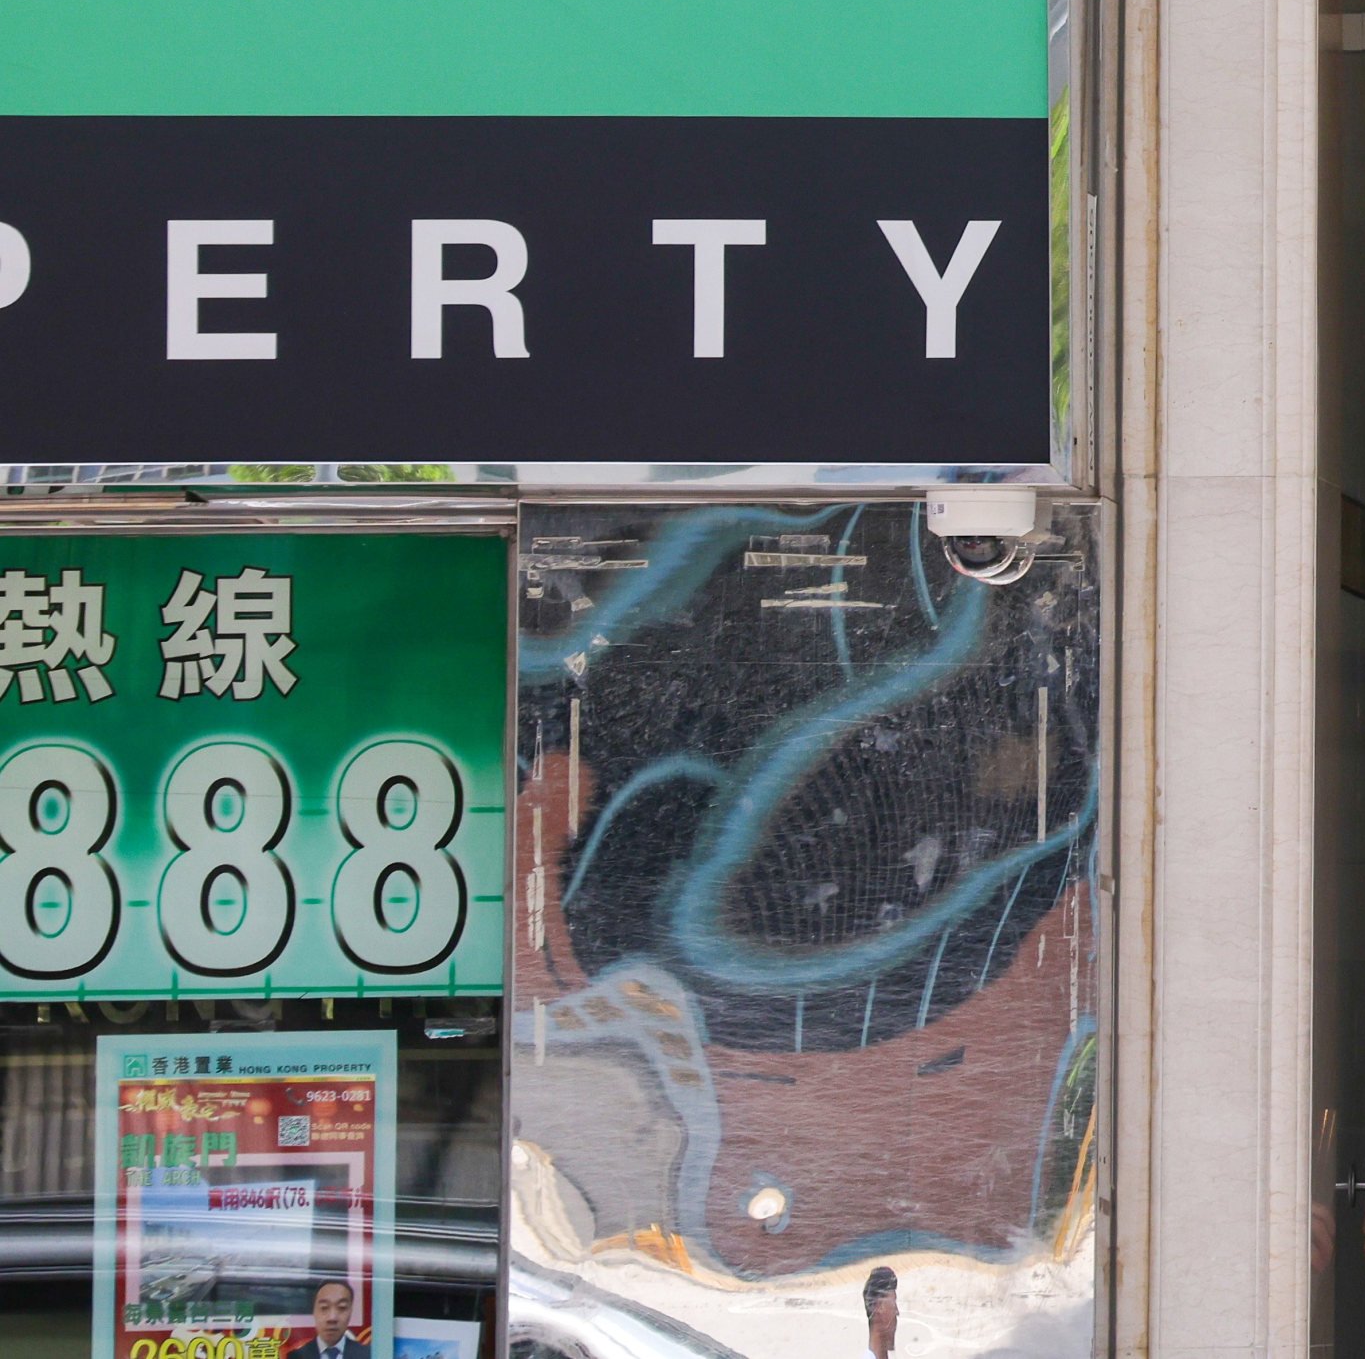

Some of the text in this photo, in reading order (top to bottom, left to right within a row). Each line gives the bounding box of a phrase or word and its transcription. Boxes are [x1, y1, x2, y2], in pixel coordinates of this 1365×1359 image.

[0, 218, 1003, 361] ERTY
[0, 566, 298, 704] 熱線
[0, 734, 468, 980] 888
[151, 1055, 372, 1075] 香港置業 HONG KONG PROPERTY
